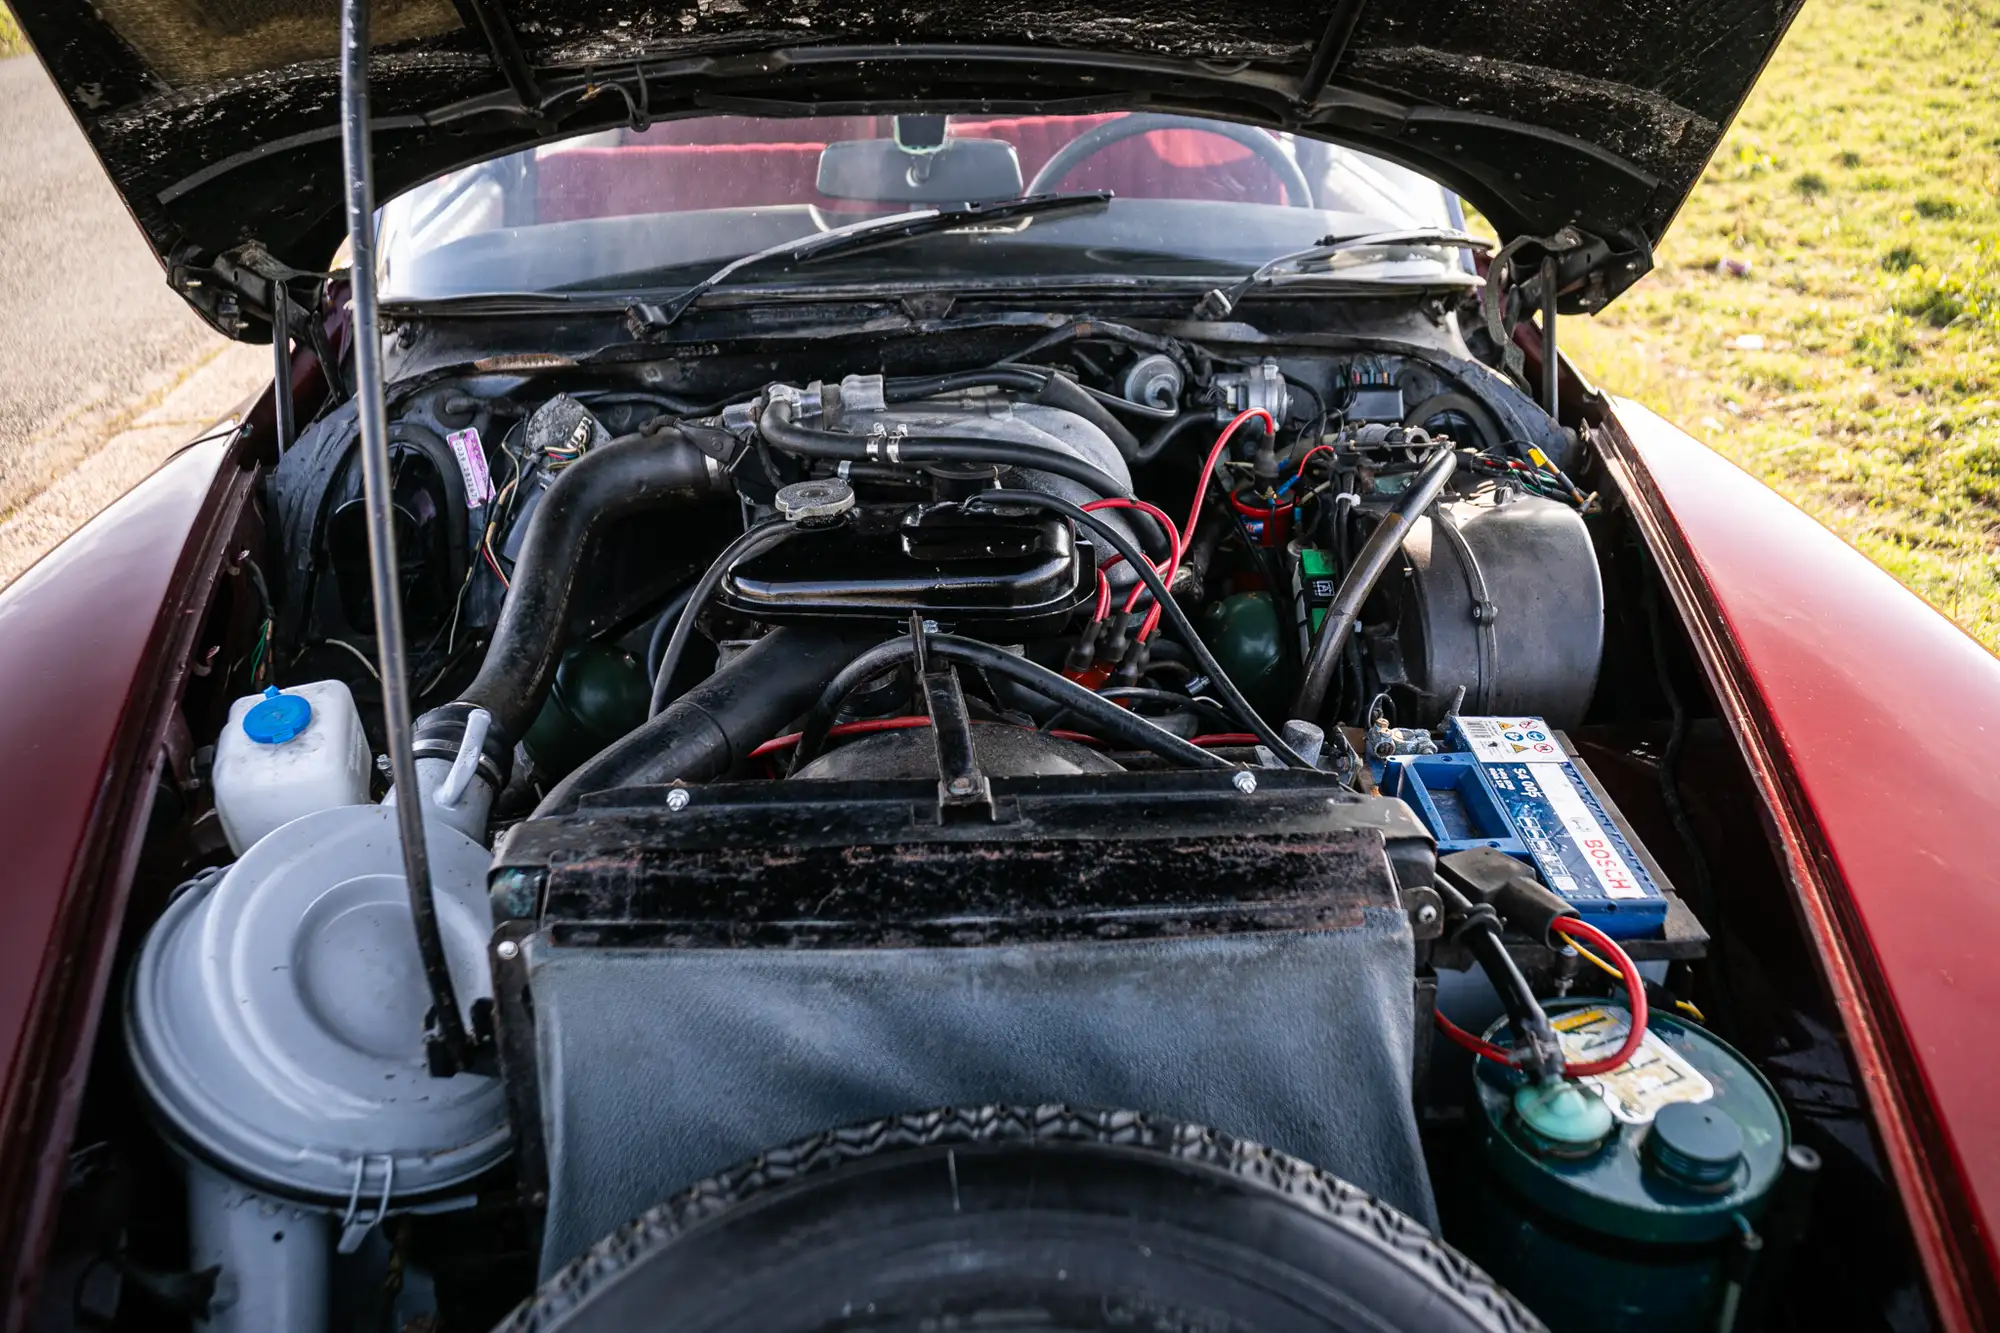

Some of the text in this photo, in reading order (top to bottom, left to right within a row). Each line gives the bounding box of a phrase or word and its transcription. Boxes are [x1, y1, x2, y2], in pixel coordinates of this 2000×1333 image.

[1511, 767, 1544, 798] S4 005
[1583, 839, 1632, 889] BOSCH
